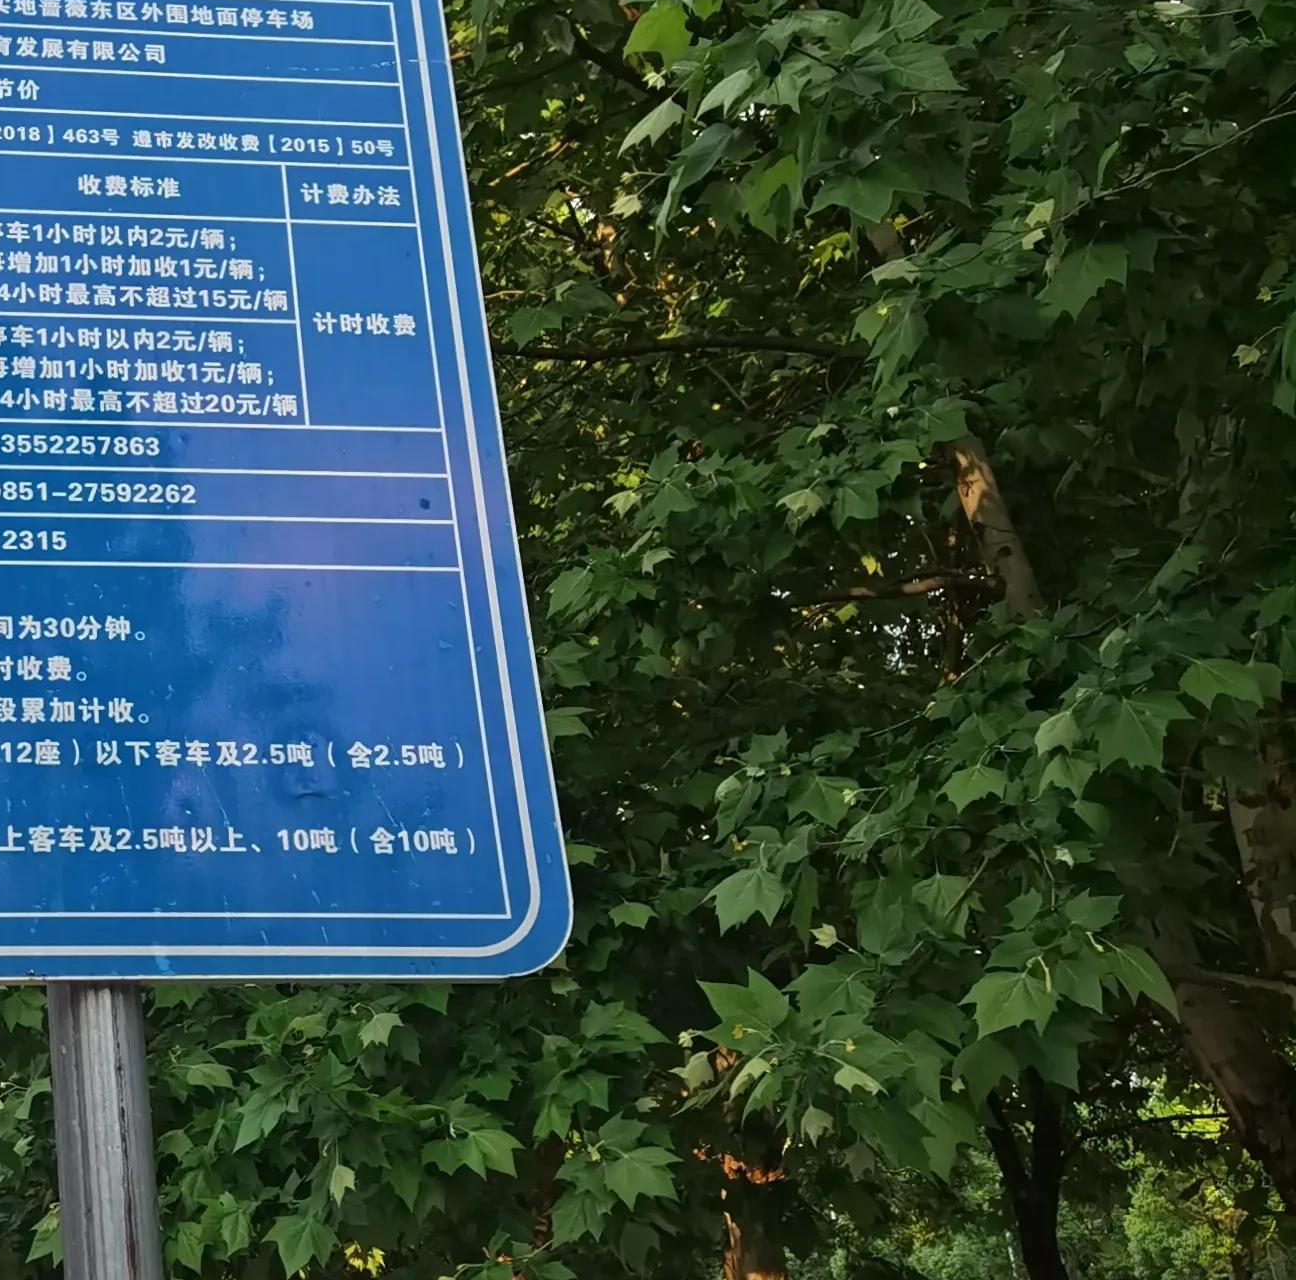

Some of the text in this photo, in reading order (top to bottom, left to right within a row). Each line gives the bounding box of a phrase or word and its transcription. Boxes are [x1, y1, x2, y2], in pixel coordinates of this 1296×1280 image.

[79, 175, 180, 198] 收费标准
[301, 183, 400, 205] 计费办法
[313, 312, 415, 335] 计时收费
